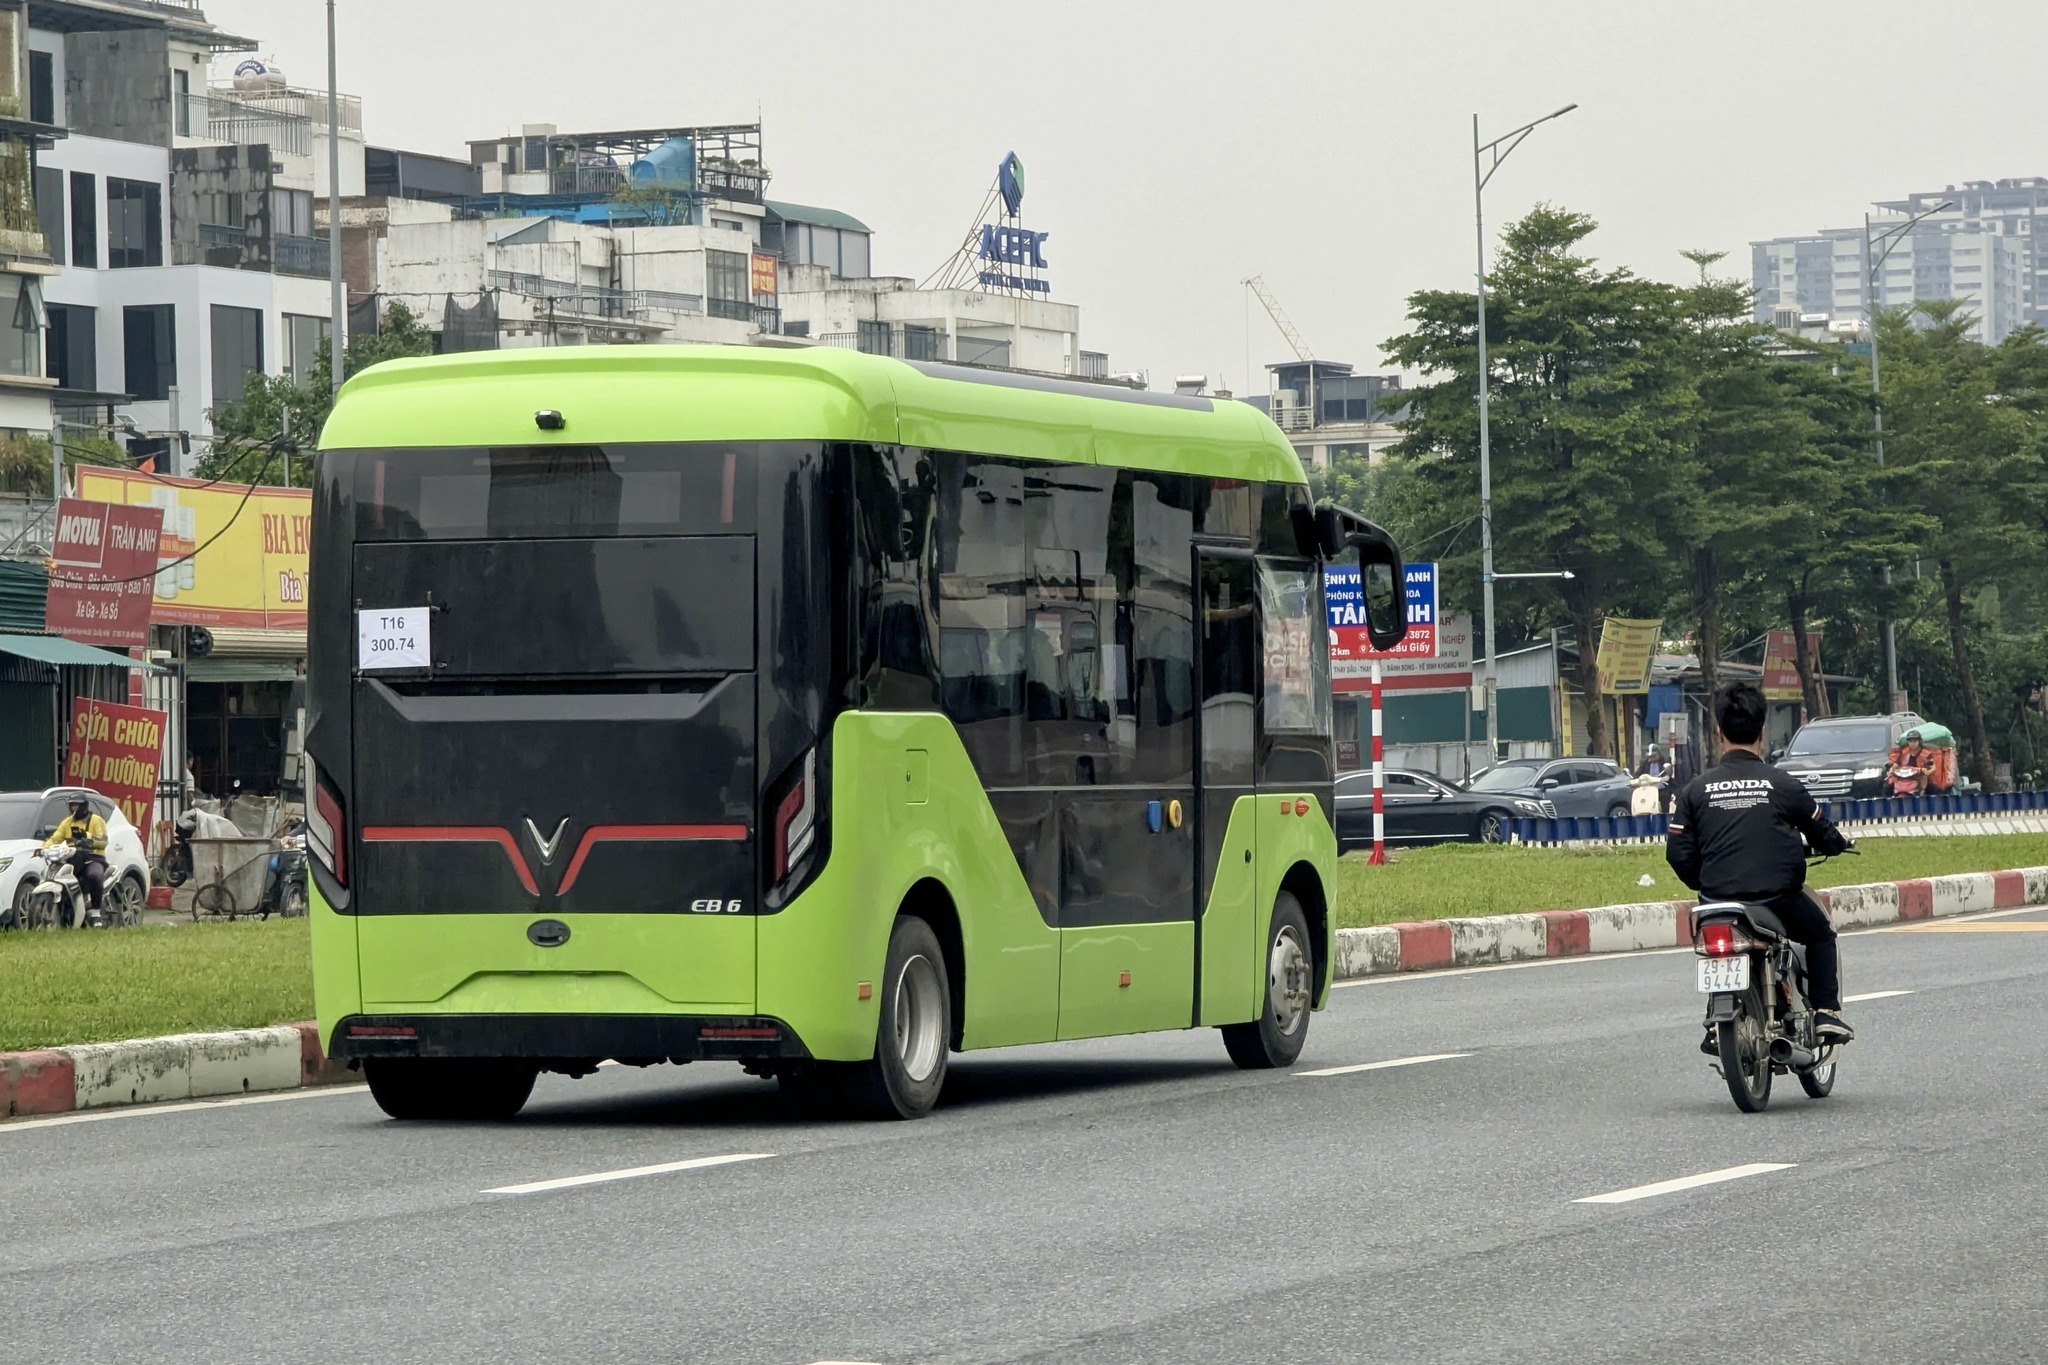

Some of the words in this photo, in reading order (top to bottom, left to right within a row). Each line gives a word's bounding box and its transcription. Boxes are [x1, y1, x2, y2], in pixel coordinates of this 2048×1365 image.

[58, 515, 101, 545] MOTUL
[263, 514, 290, 554] BIA
[135, 528, 157, 552] ANH
[280, 569, 303, 602] Bia
[1406, 572, 1431, 583] ANH
[76, 600, 85, 618] Xe
[86, 601, 95, 618] Ga
[100, 602, 108, 620] Xe
[109, 600, 119, 621] Số
[380, 616, 405, 630] T16
[1409, 630, 1430, 640] 3872
[371, 637, 415, 652] 300.74
[1409, 643, 1430, 654] Giấy
[76, 706, 109, 742] SỬA
[114, 717, 159, 750] CHỮA
[69, 745, 101, 780] BẢO
[103, 755, 155, 788] DƯỠNG
[1705, 780, 1774, 793] HONDA
[1710, 791, 1738, 799] Honda
[727, 900, 742, 912] 6
[1704, 973, 1741, 990] 9444
